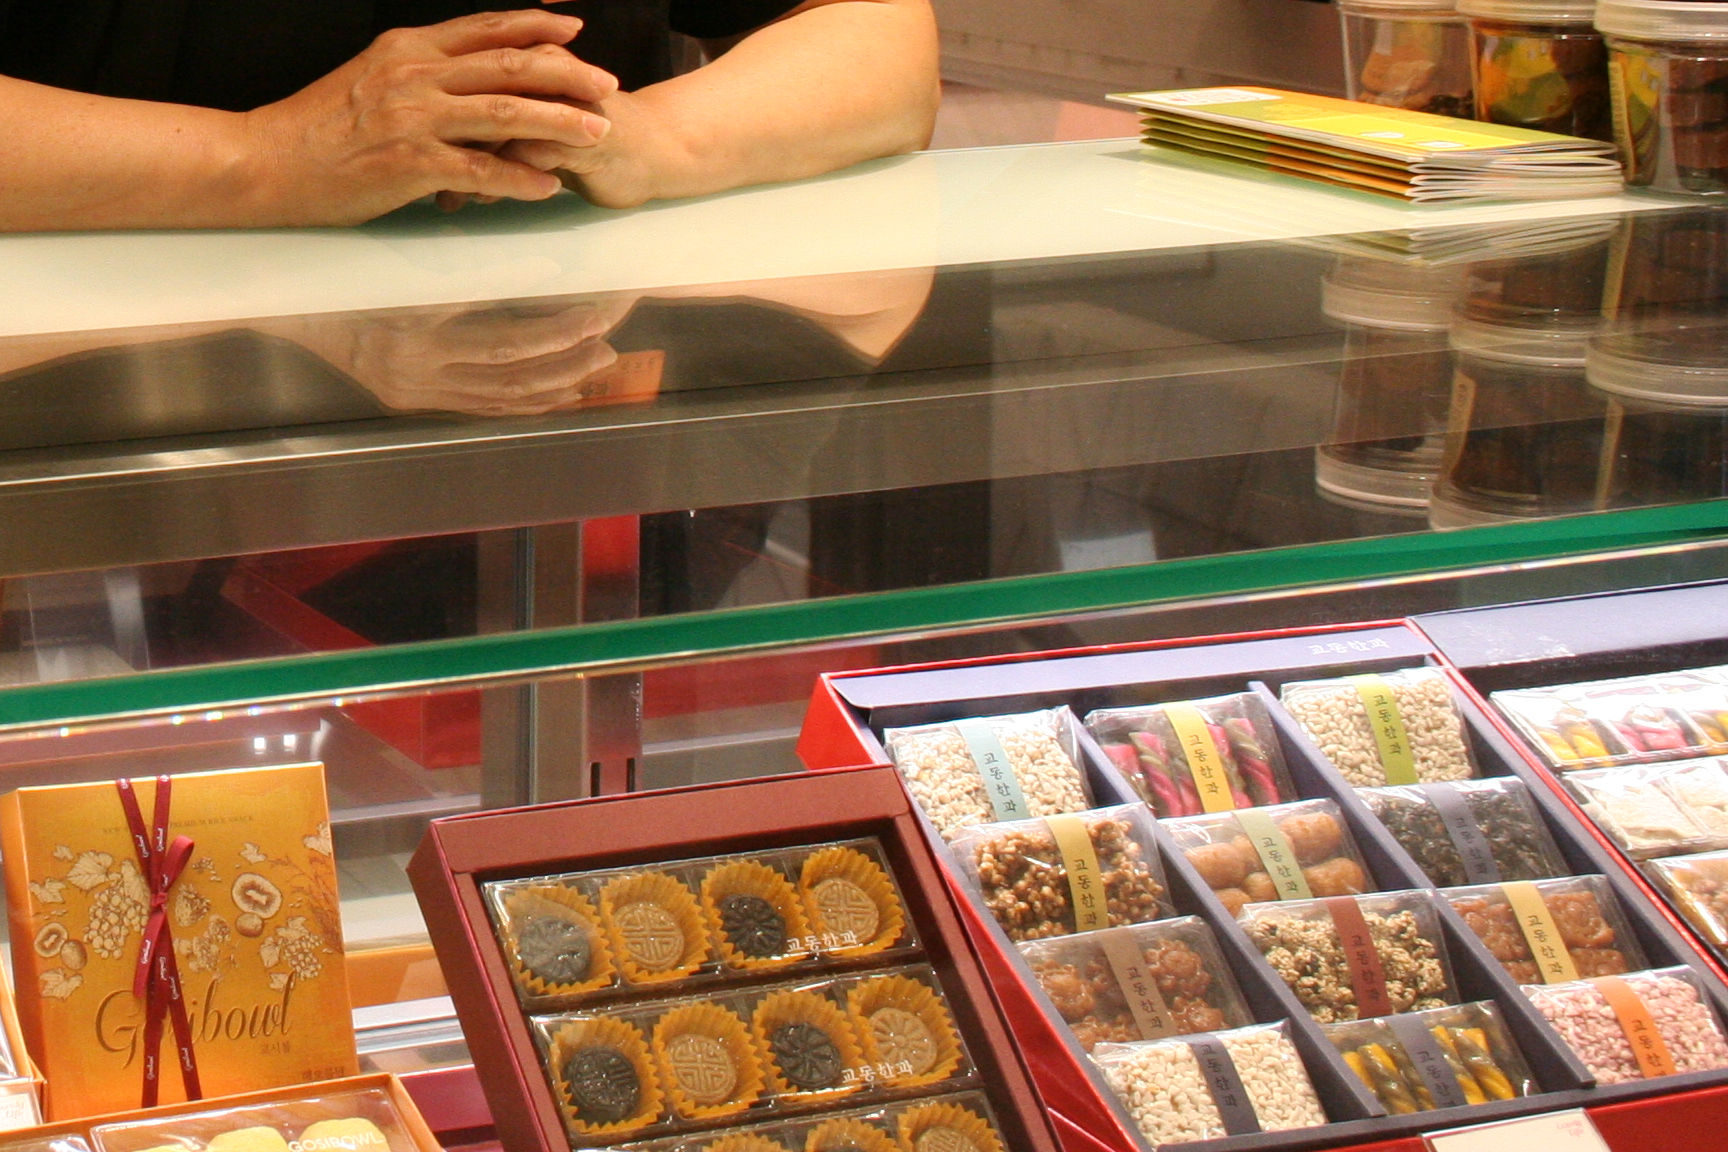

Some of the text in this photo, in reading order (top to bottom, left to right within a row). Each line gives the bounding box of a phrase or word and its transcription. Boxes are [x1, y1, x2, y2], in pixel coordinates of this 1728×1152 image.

[1308, 637, 1390, 655] 교동한과
[1373, 693, 1402, 756] 교동한과
[983, 751, 1018, 813] 교동한과
[1189, 733, 1220, 796] 교동한과
[1073, 858, 1098, 926] 교동한과
[1261, 837, 1300, 894] 교동한과
[786, 930, 859, 954] 교동한과
[1526, 914, 1564, 975] 교동한과
[1126, 966, 1164, 1030] 교동한과
[840, 1059, 914, 1084] 교동한과
[1200, 1045, 1238, 1109] 교동한과
[288, 1131, 384, 1152] GOSIBOWL
